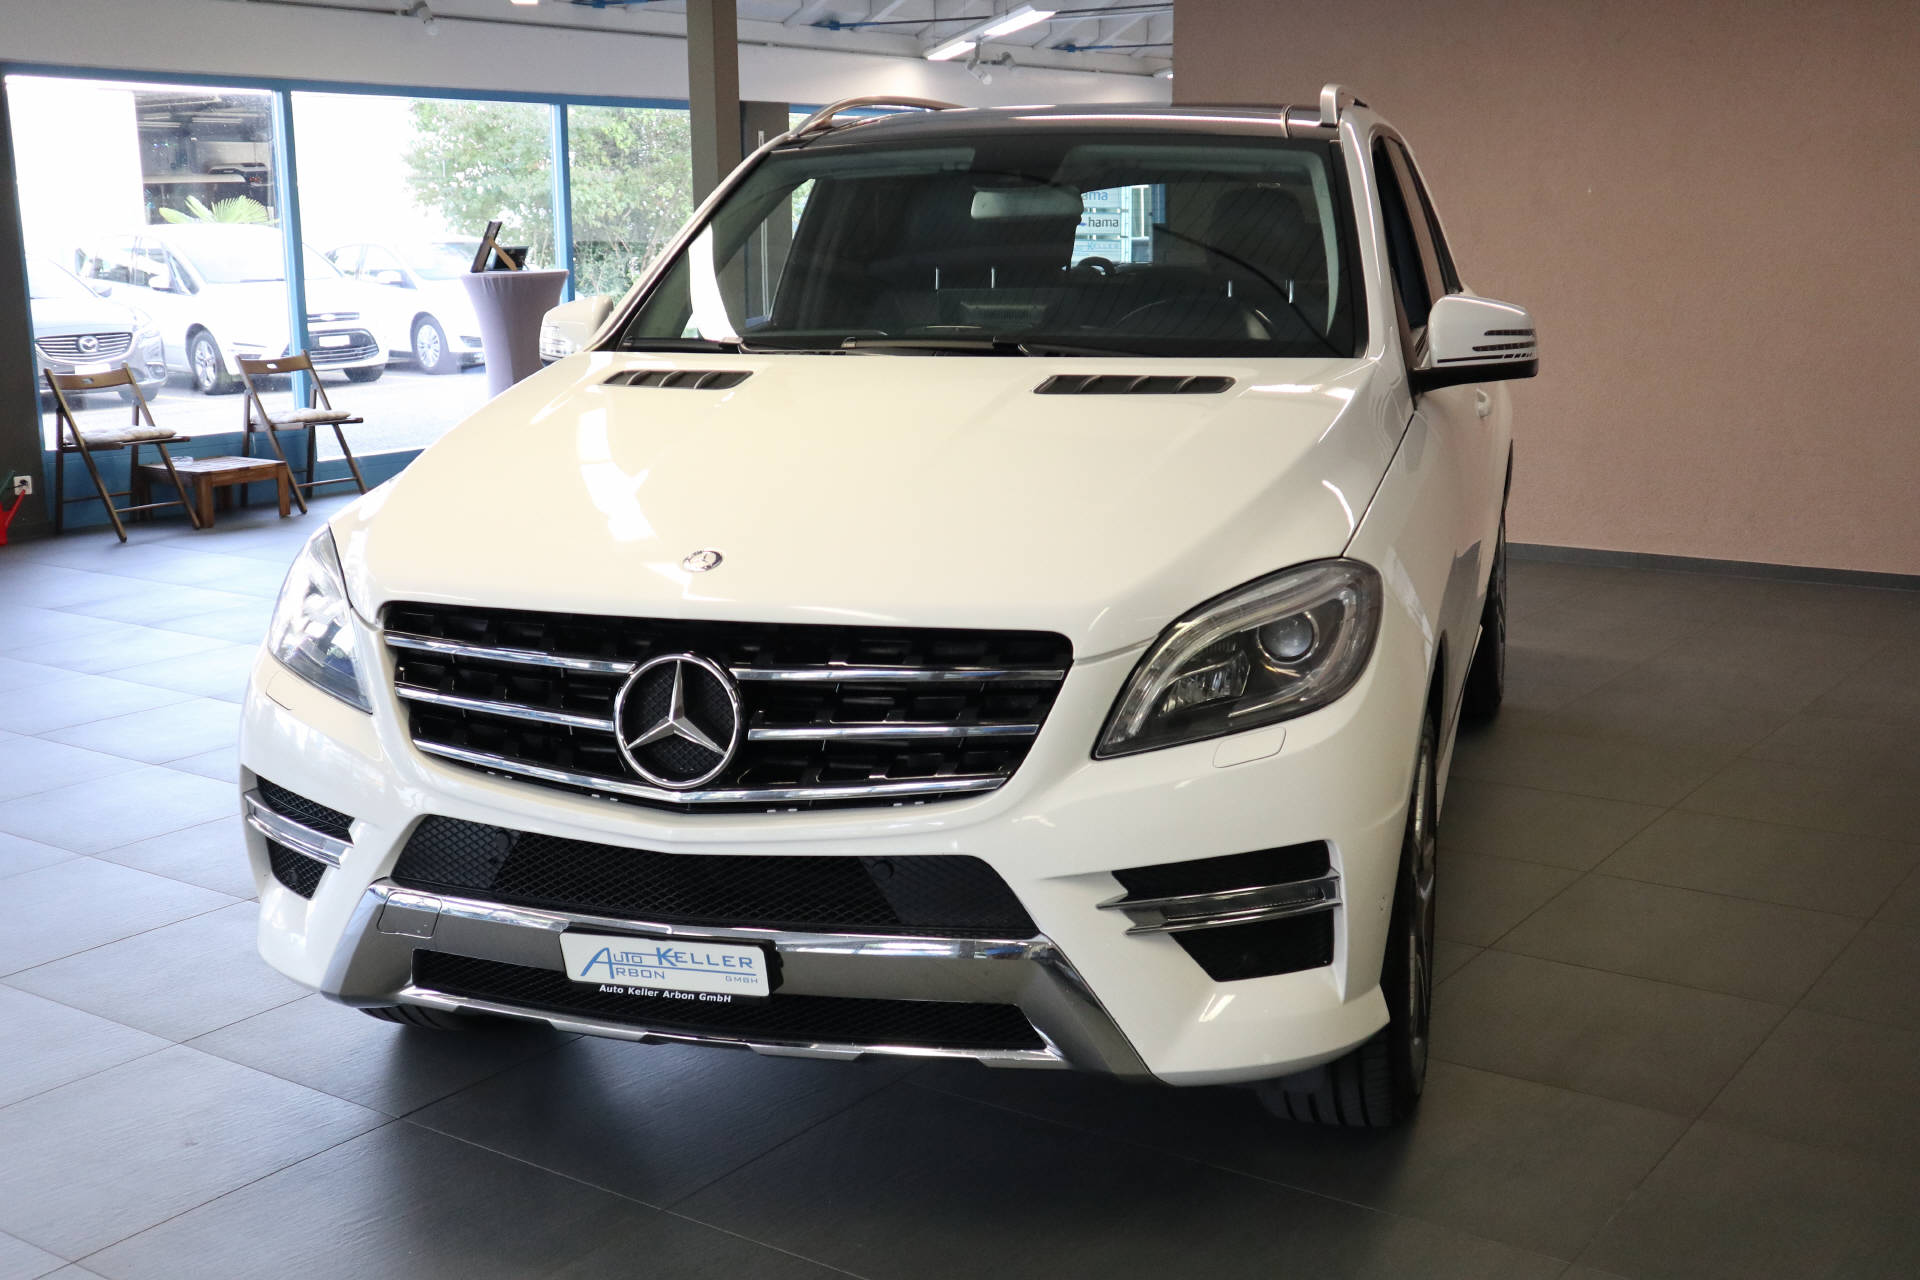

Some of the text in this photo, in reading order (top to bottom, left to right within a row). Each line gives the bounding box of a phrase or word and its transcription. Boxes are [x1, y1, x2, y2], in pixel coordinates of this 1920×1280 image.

[1088, 217, 1119, 228] hama
[656, 947, 753, 969] KELLER
[725, 975, 758, 984] GMBH
[599, 984, 732, 1003] Auto Keller Arbon GmbH
